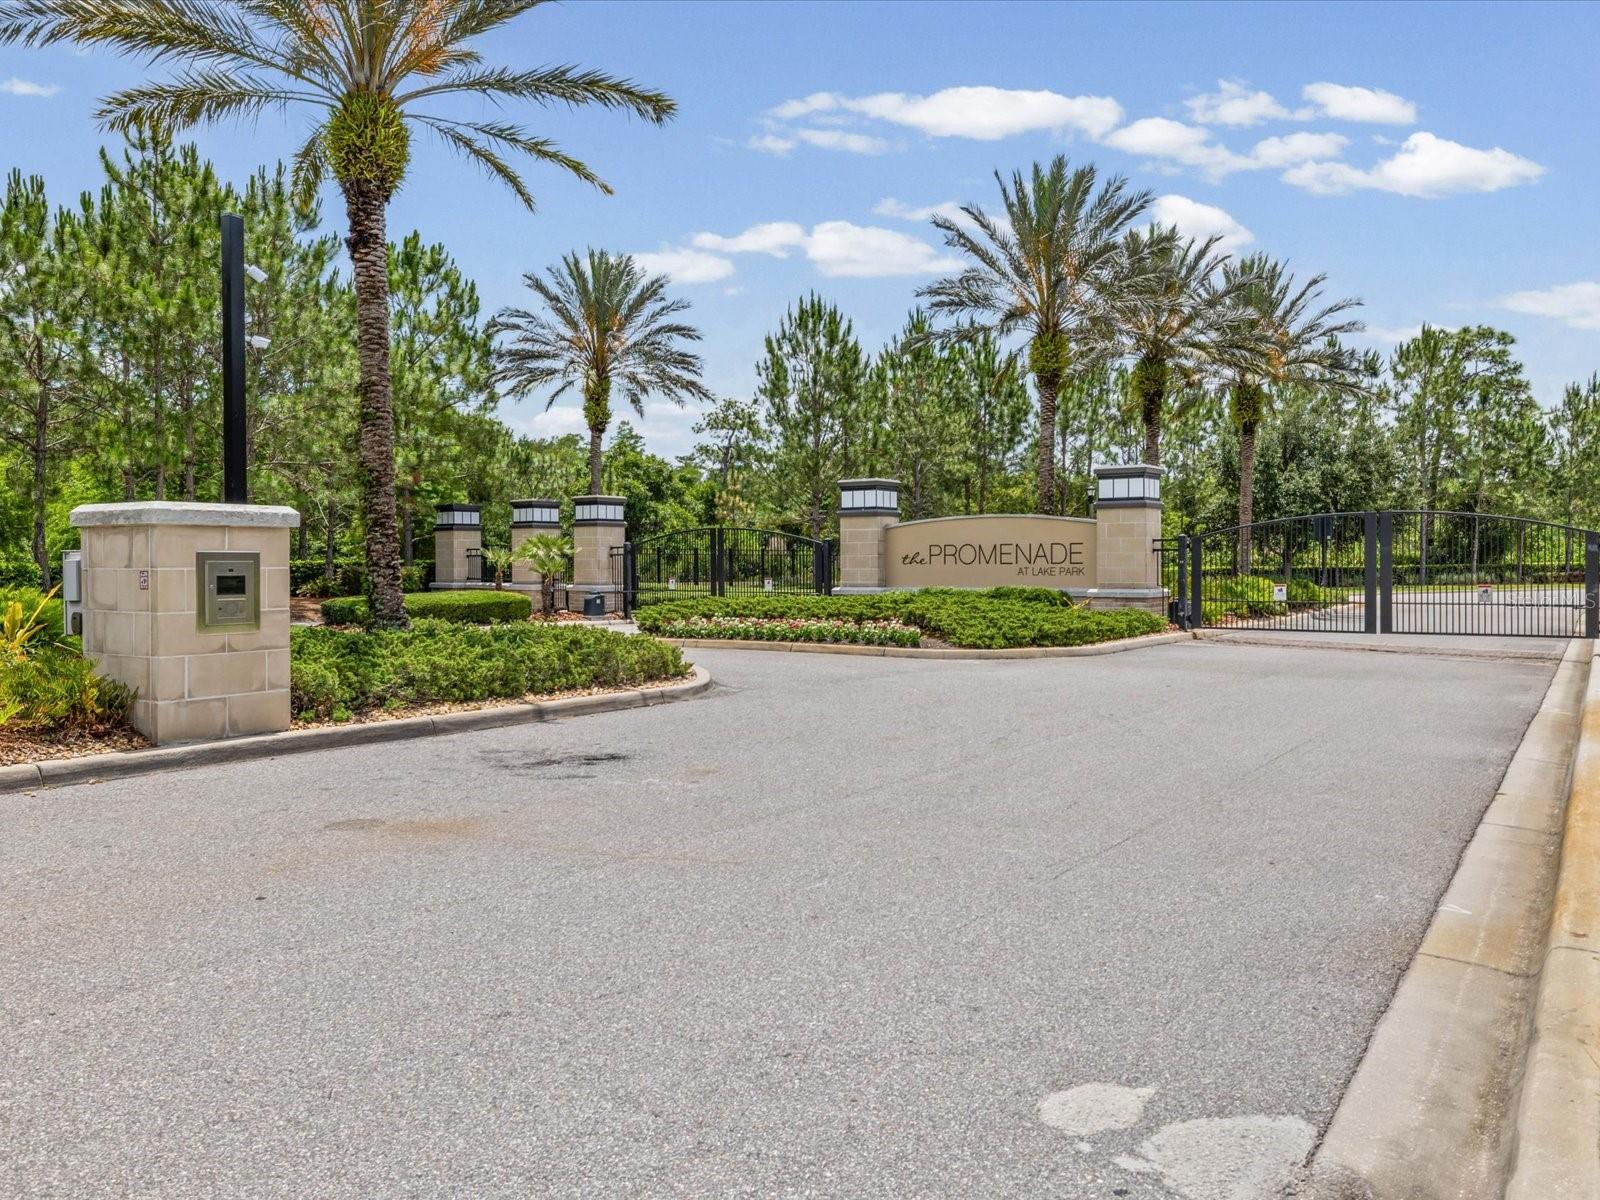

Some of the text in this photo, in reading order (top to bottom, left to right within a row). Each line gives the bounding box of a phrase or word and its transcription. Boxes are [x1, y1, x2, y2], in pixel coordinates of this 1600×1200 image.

[902, 543, 1084, 565] the PROMENADE
[1017, 566, 1086, 576] AT LAKE PARK
